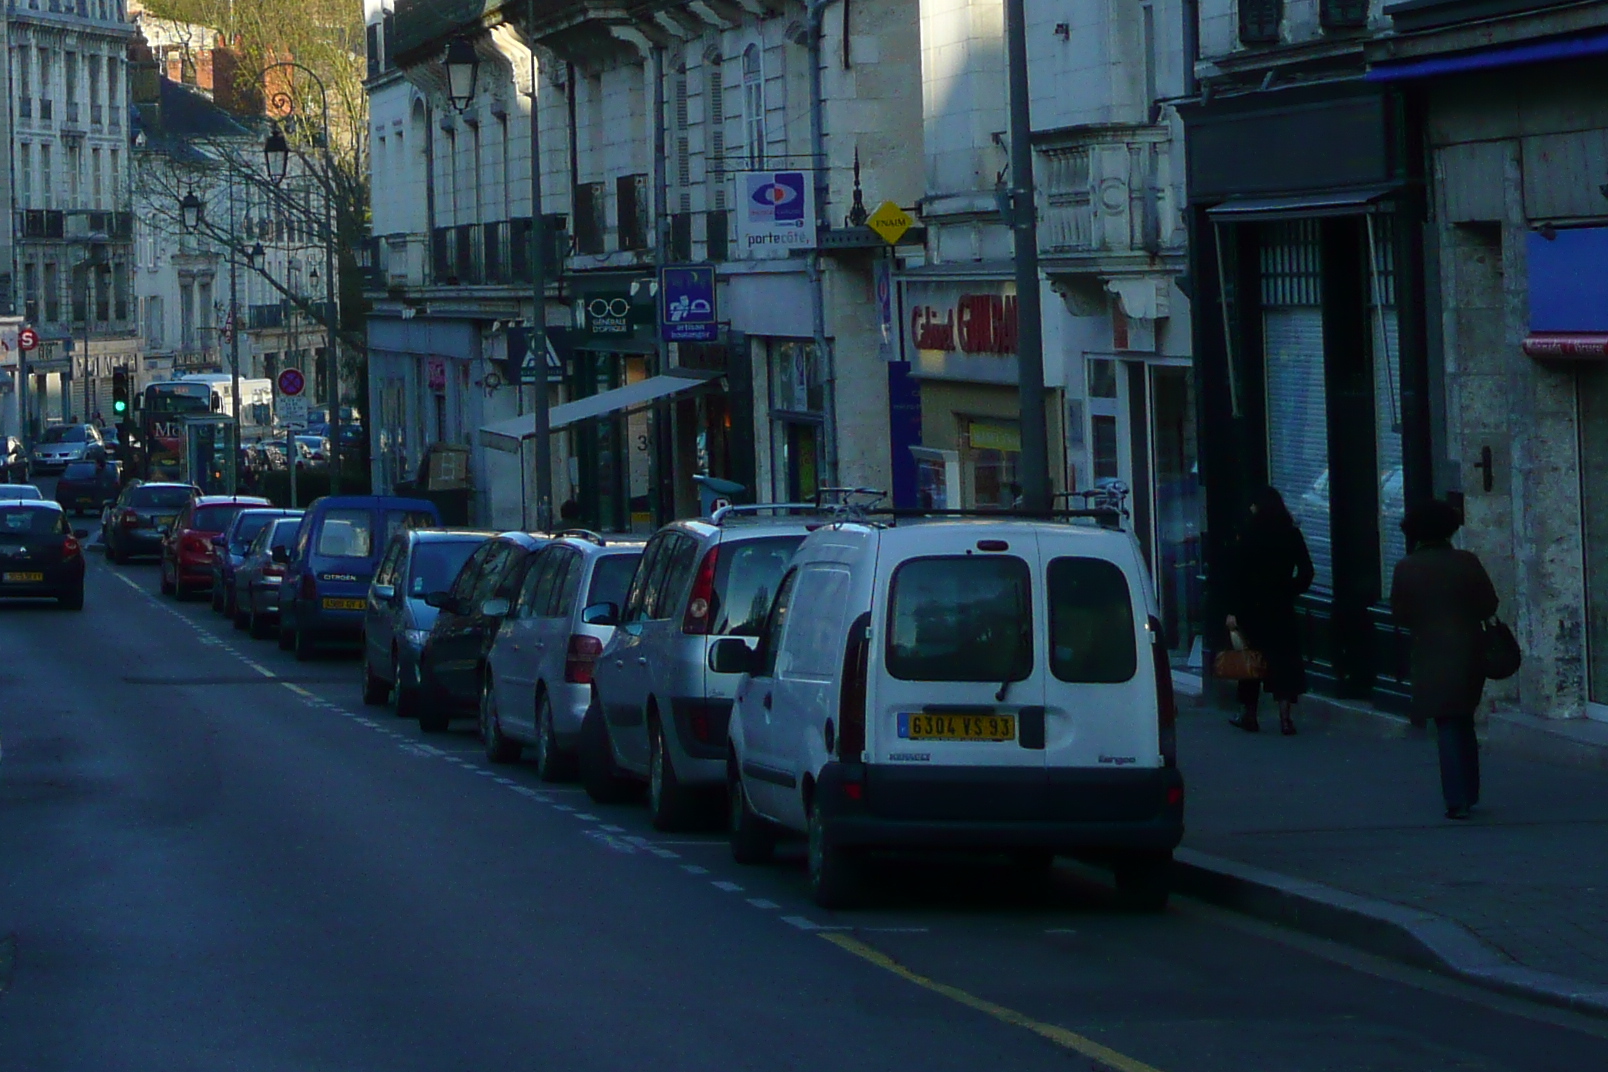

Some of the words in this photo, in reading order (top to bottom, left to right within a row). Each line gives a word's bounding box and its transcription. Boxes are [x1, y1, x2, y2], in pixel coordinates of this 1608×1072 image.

[875, 218, 907, 228] FNAIM
[21, 331, 34, 346] S
[912, 716, 956, 736] 6304
[962, 716, 983, 736] VS
[989, 718, 1011, 737] 93
